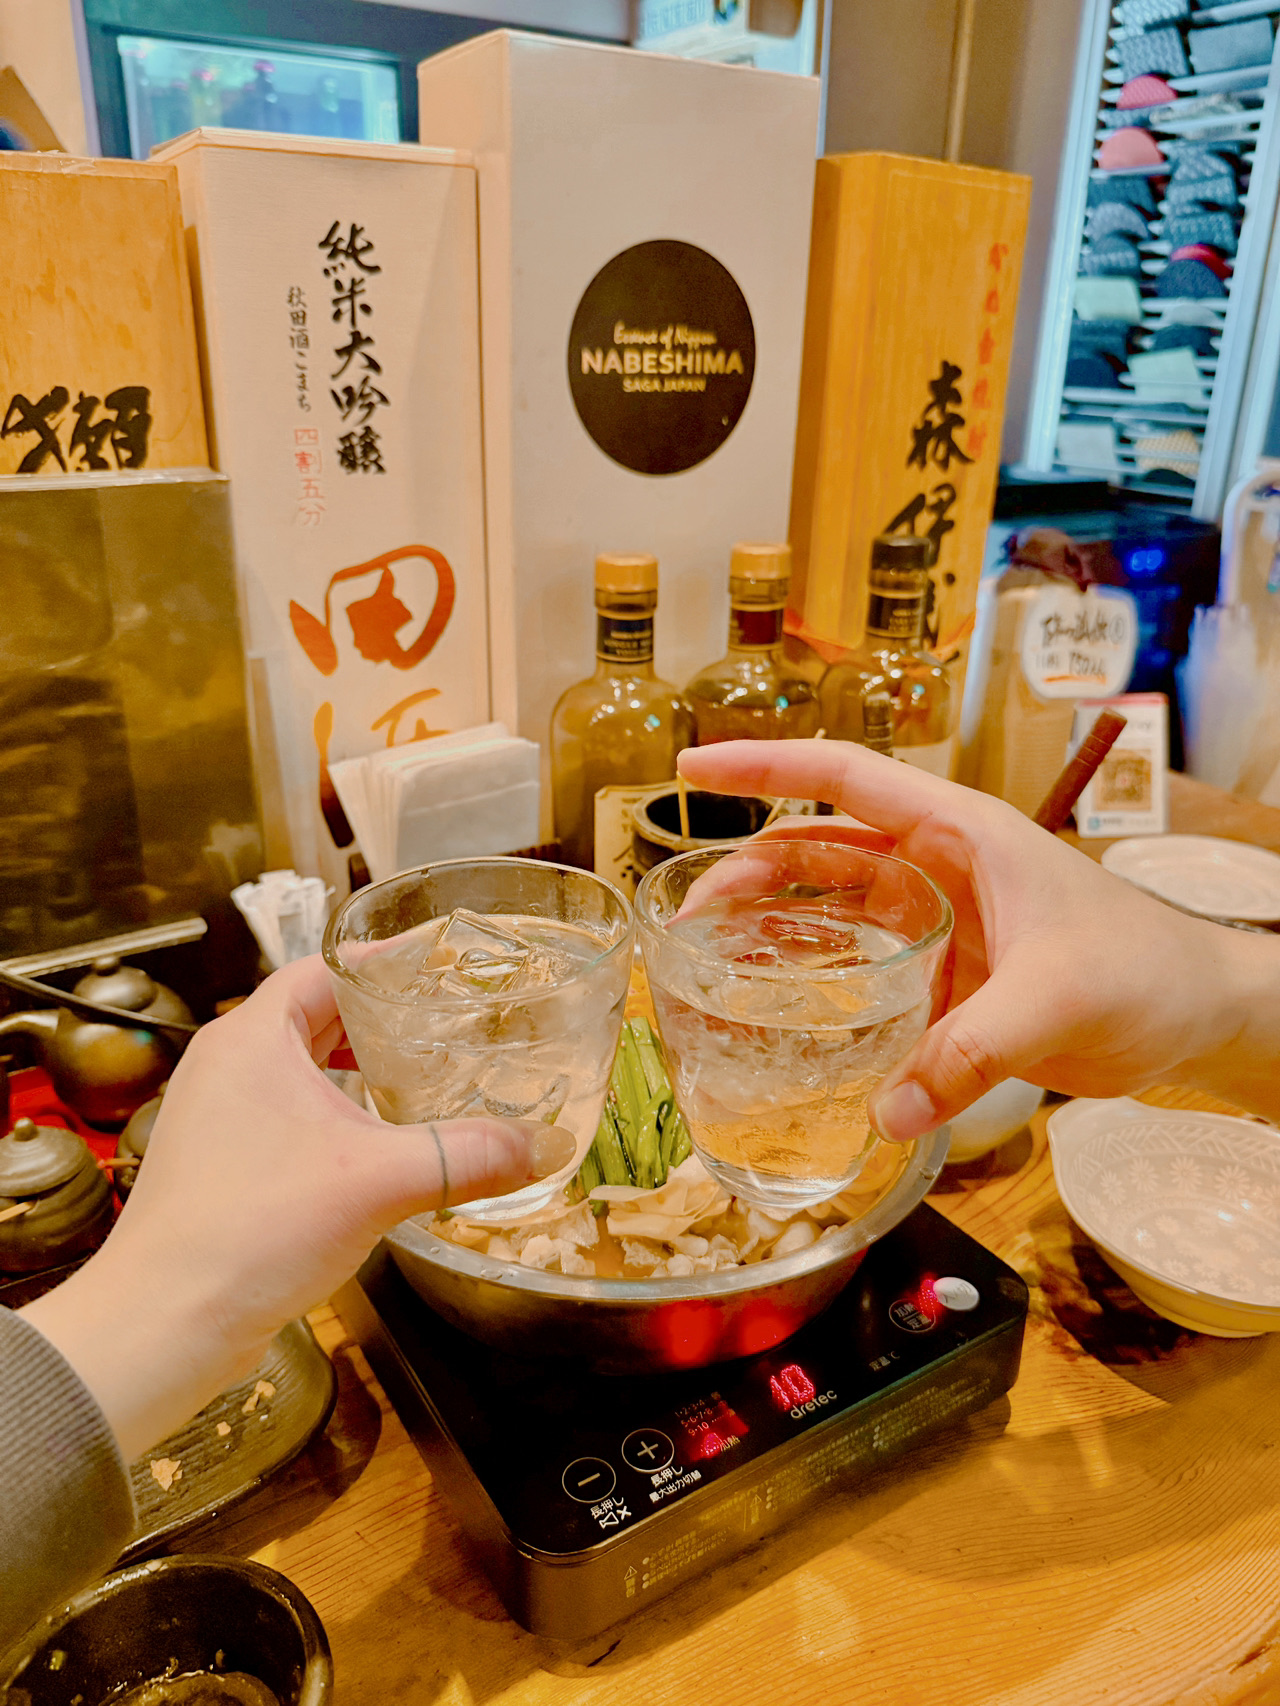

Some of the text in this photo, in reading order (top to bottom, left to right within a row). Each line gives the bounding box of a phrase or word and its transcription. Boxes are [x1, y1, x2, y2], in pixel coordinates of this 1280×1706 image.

[581, 347, 744, 375] NABESHIMA
[623, 376, 706, 393] SAGA JAPAN
[294, 428, 327, 527] 四割五分
[769, 1365, 815, 1411] 10
[790, 1390, 837, 1419] dretec
[650, 1466, 684, 1488] 長押し
[590, 1497, 625, 1520] 長押し
